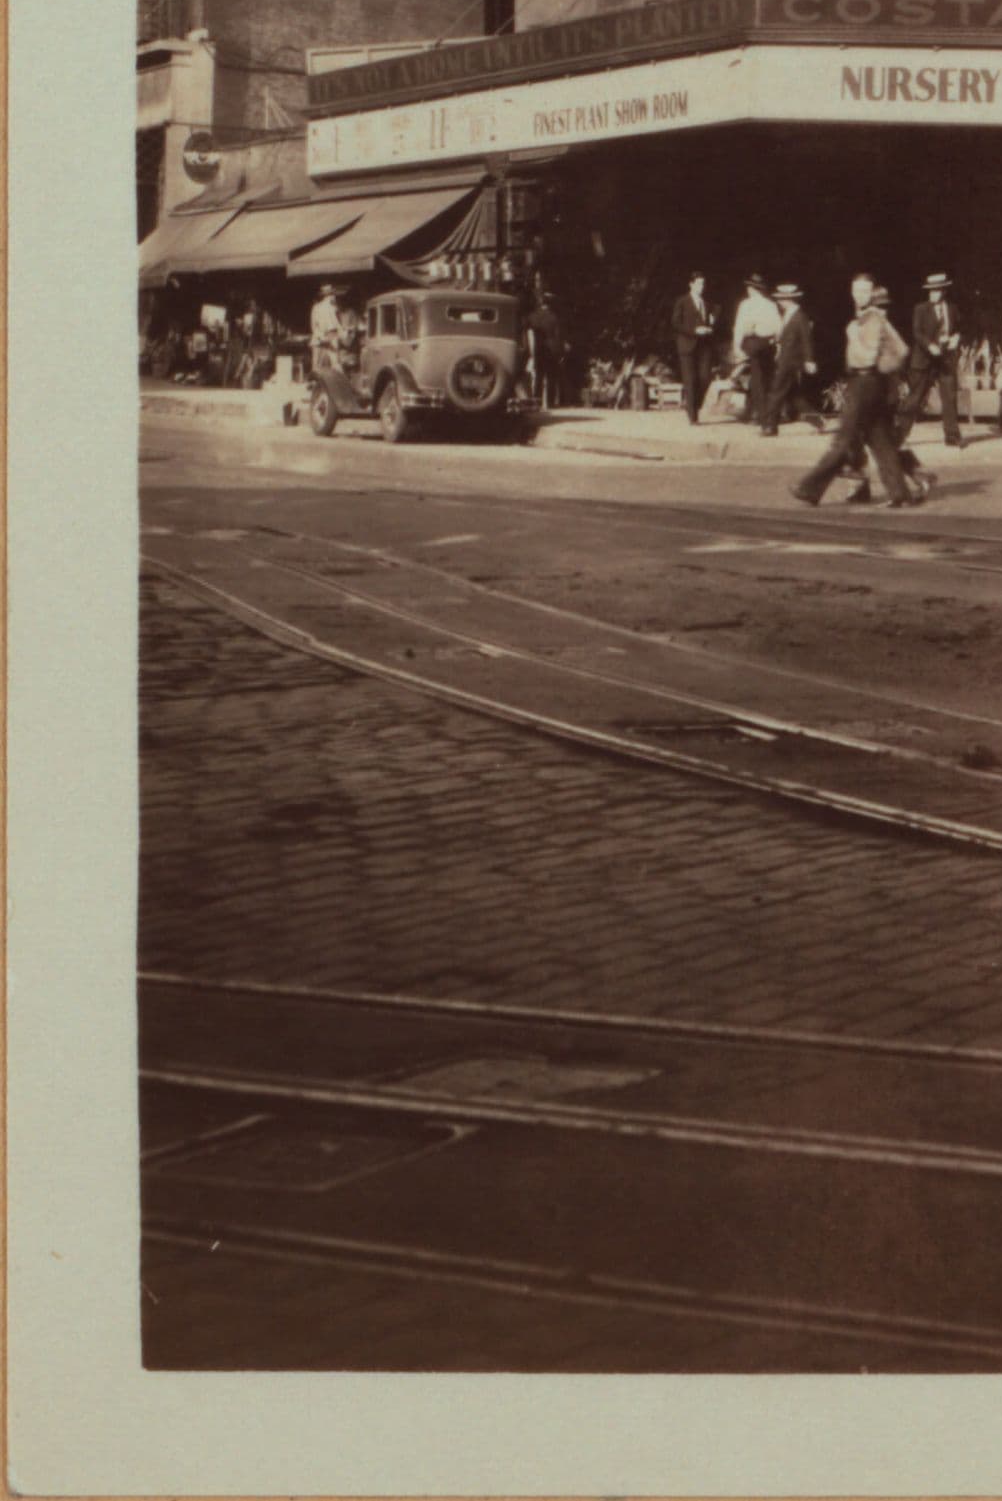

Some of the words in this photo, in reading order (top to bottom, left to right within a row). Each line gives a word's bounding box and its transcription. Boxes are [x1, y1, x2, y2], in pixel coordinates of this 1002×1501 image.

[354, 64, 391, 94] NOT
[399, 58, 412, 85] A
[416, 44, 477, 84] HOME
[484, 28, 554, 72] UNTIL
[840, 65, 1001, 105] NURSERY
[533, 109, 573, 137] FINEST
[574, 101, 609, 132] PLANT
[615, 96, 648, 125] SHOW
[652, 90, 688, 119] ROOM
